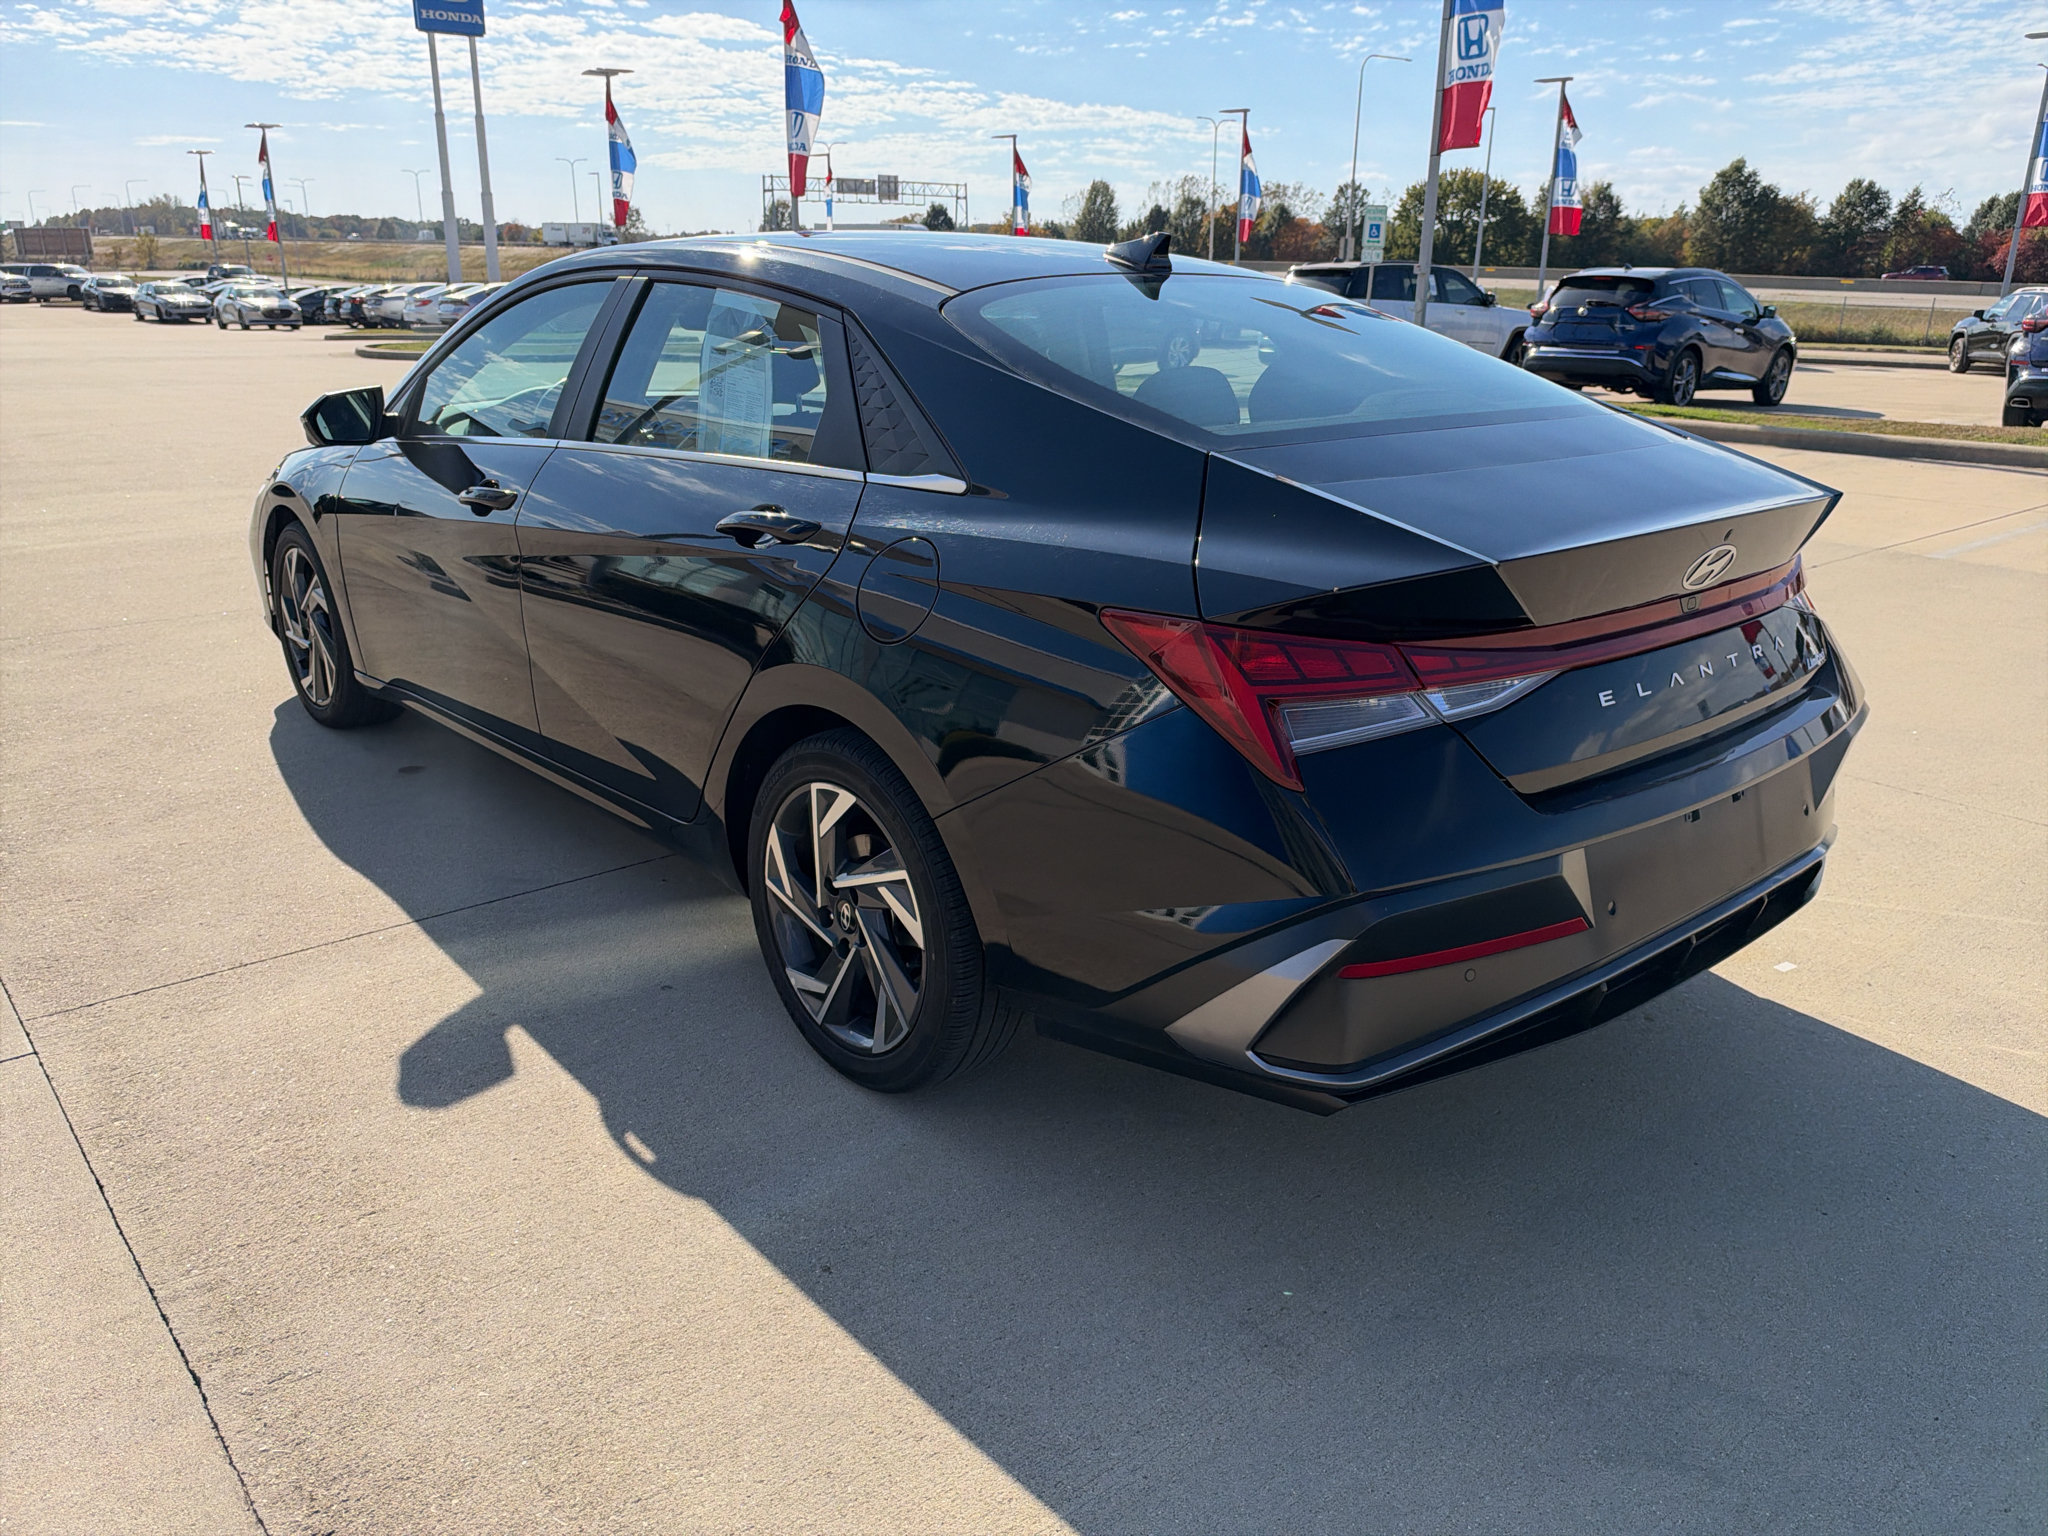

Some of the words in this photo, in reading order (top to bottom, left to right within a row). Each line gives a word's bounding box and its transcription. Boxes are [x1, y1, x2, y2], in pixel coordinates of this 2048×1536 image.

[420, 9, 484, 25] HONDA
[785, 54, 820, 70] HOND
[1449, 62, 1492, 84] HOND
[1598, 635, 1785, 707] ELANTRA
